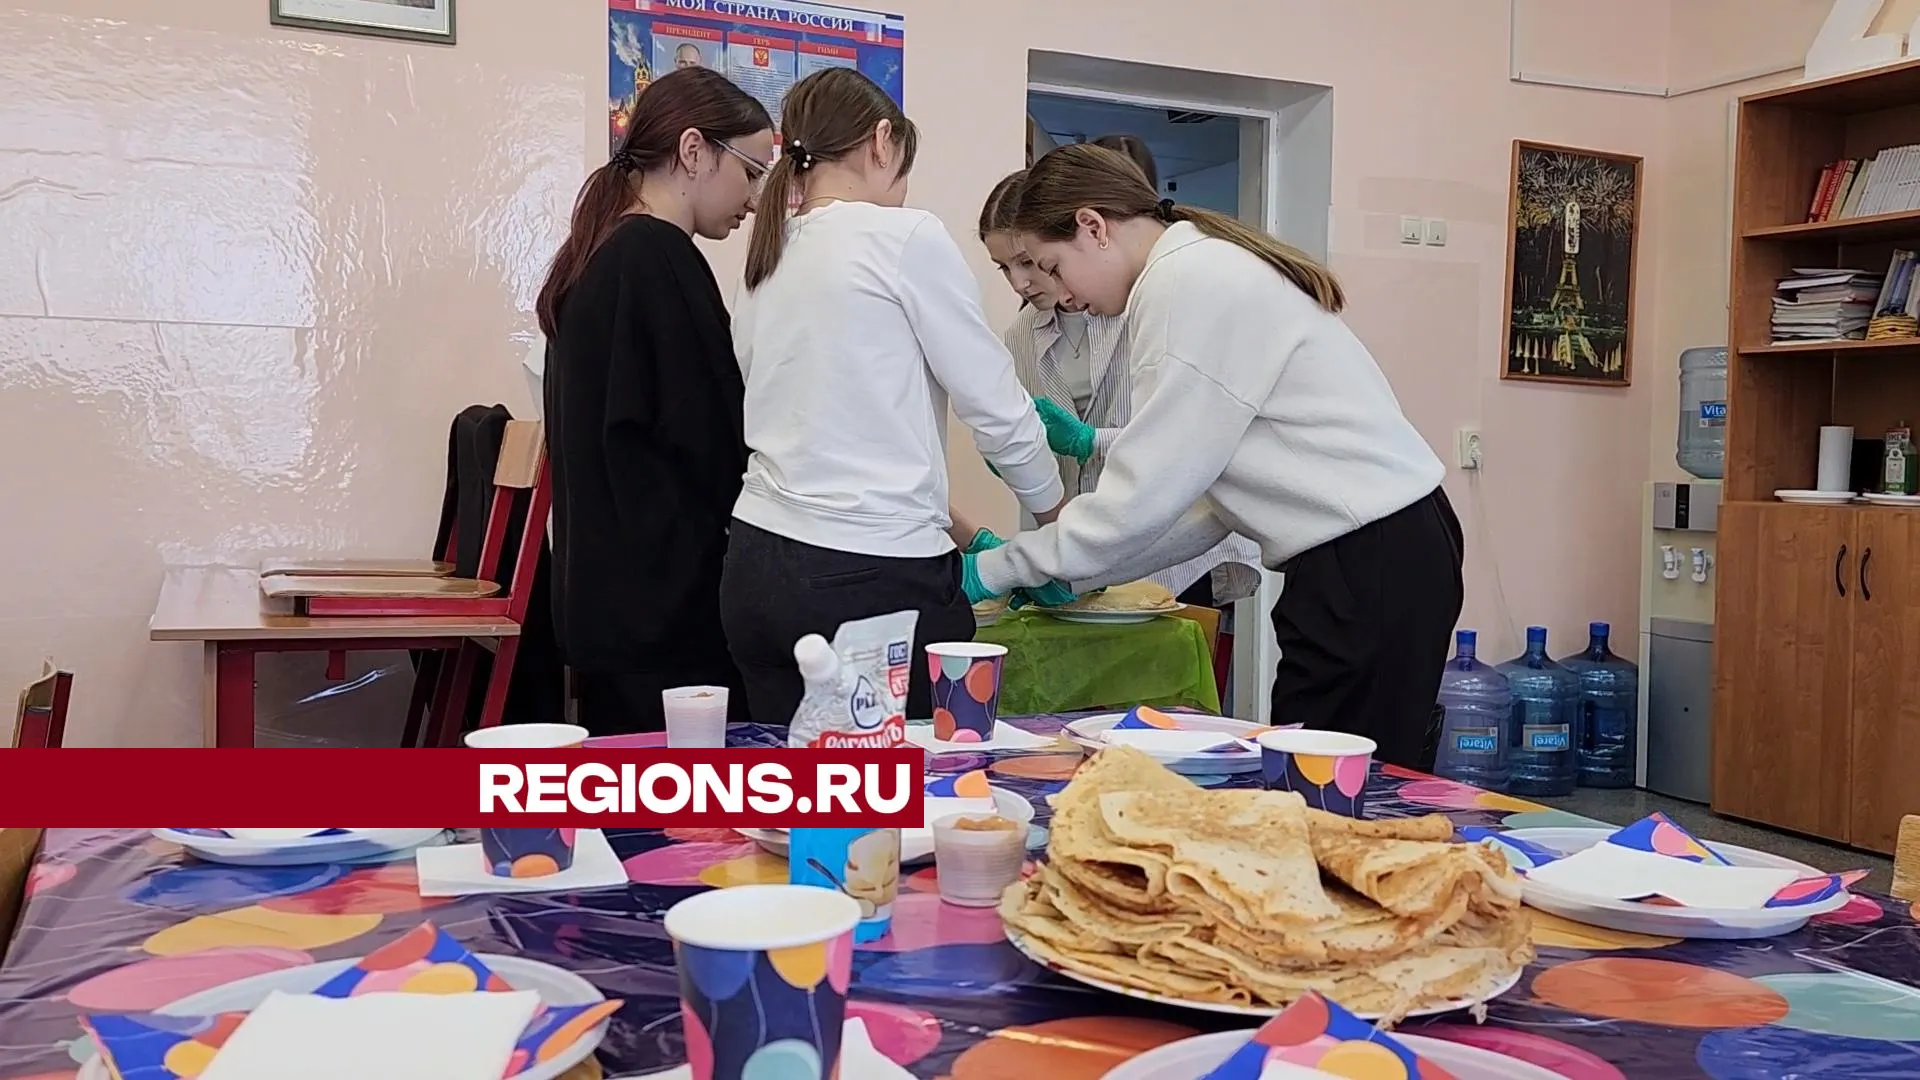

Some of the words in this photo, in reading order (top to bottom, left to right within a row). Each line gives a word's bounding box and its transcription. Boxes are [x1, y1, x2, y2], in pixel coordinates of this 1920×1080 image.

[666, 0, 706, 11] МОЯ
[713, 1, 782, 22] СТРАНА
[788, 10, 854, 32] РОССИЯ
[1459, 735, 1494, 750] Vitarel
[1533, 734, 1566, 748] Vitarel
